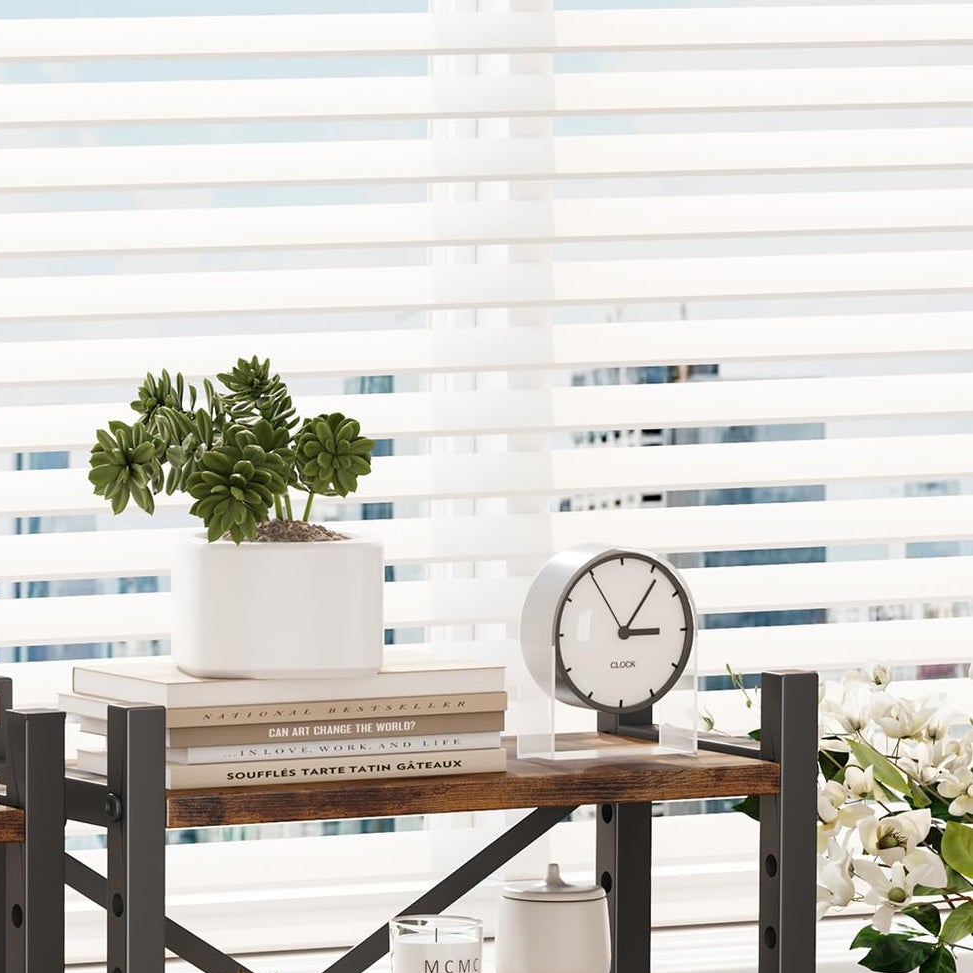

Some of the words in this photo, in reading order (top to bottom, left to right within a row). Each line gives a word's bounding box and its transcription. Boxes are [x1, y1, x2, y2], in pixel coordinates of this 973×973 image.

[610, 661, 636, 669] CLOCK
[202, 708, 312, 721] NATIONAL
[328, 700, 466, 714] BESTSELLER
[268, 727, 289, 738] CAN
[291, 726, 310, 737] ART
[313, 724, 352, 736] CHANGE
[355, 722, 373, 734] THE
[376, 721, 416, 733] WORLD?
[378, 741, 412, 750] AND
[422, 739, 461, 747] LIFE
[227, 767, 297, 780] SOUFFLÉS
[301, 766, 346, 776] TARTE
[349, 763, 391, 773] TATIN
[396, 759, 462, 771] GÂTEAUX
